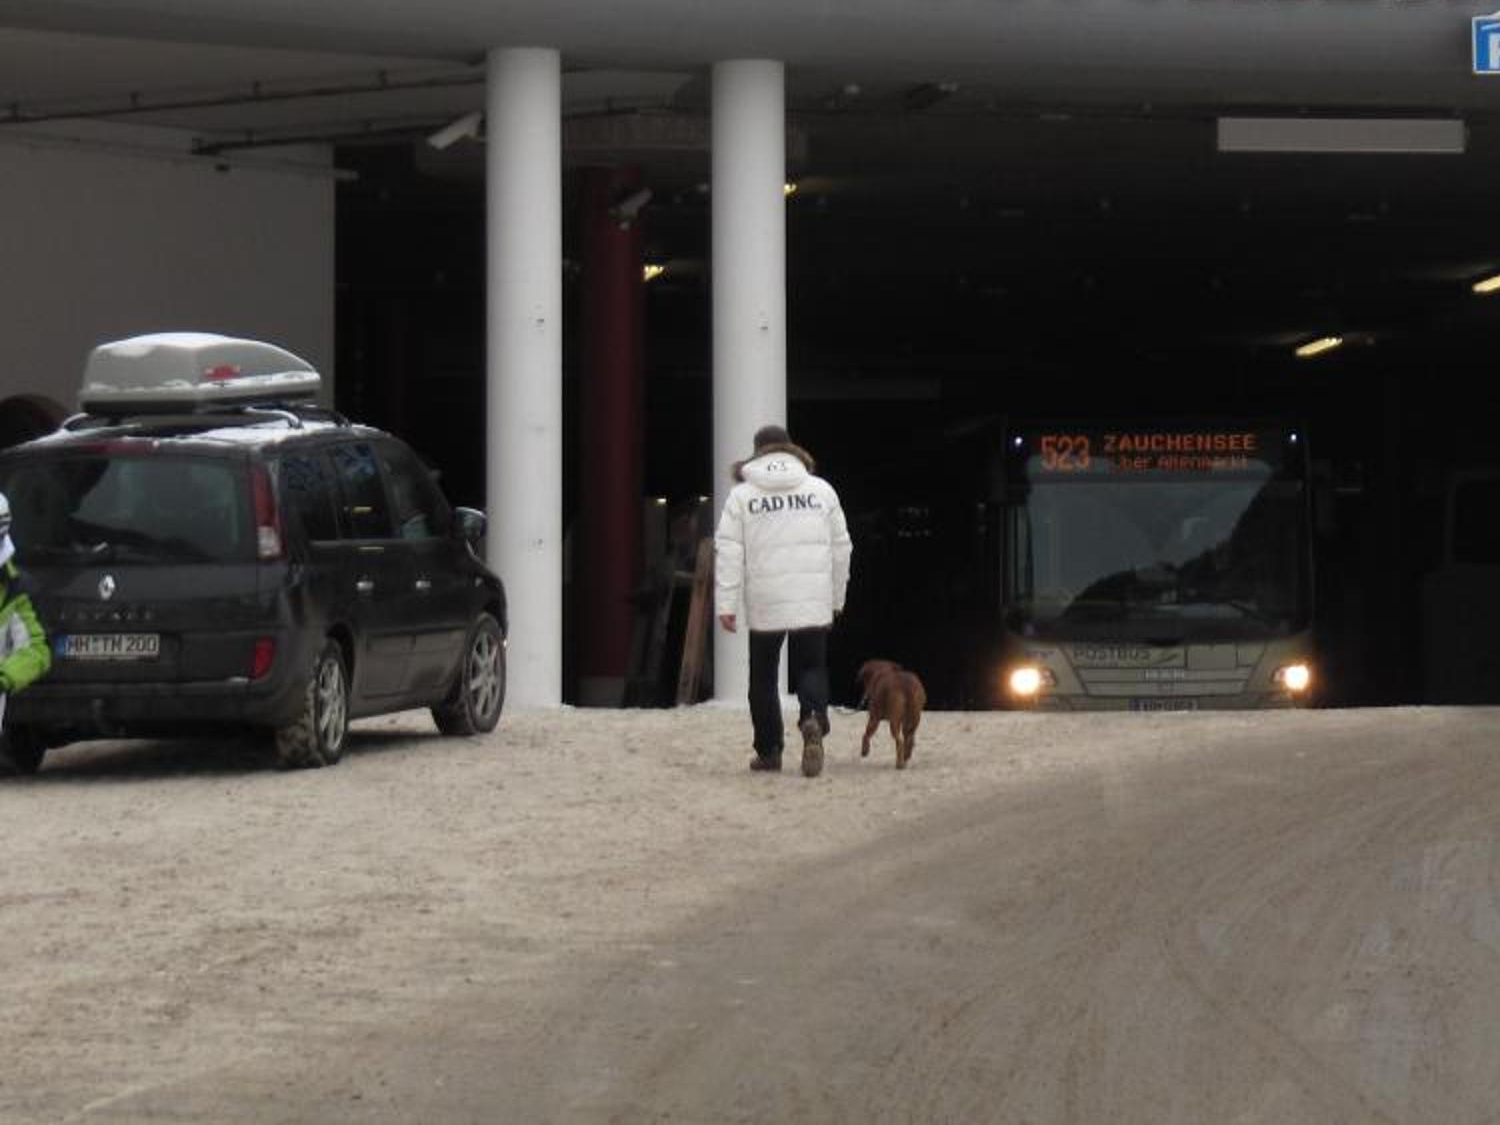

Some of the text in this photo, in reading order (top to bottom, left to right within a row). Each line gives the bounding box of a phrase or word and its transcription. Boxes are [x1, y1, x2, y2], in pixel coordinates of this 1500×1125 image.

[1040, 433, 1257, 471] 523 ZAUCHENSEE
[748, 493, 823, 514] CAD INC.
